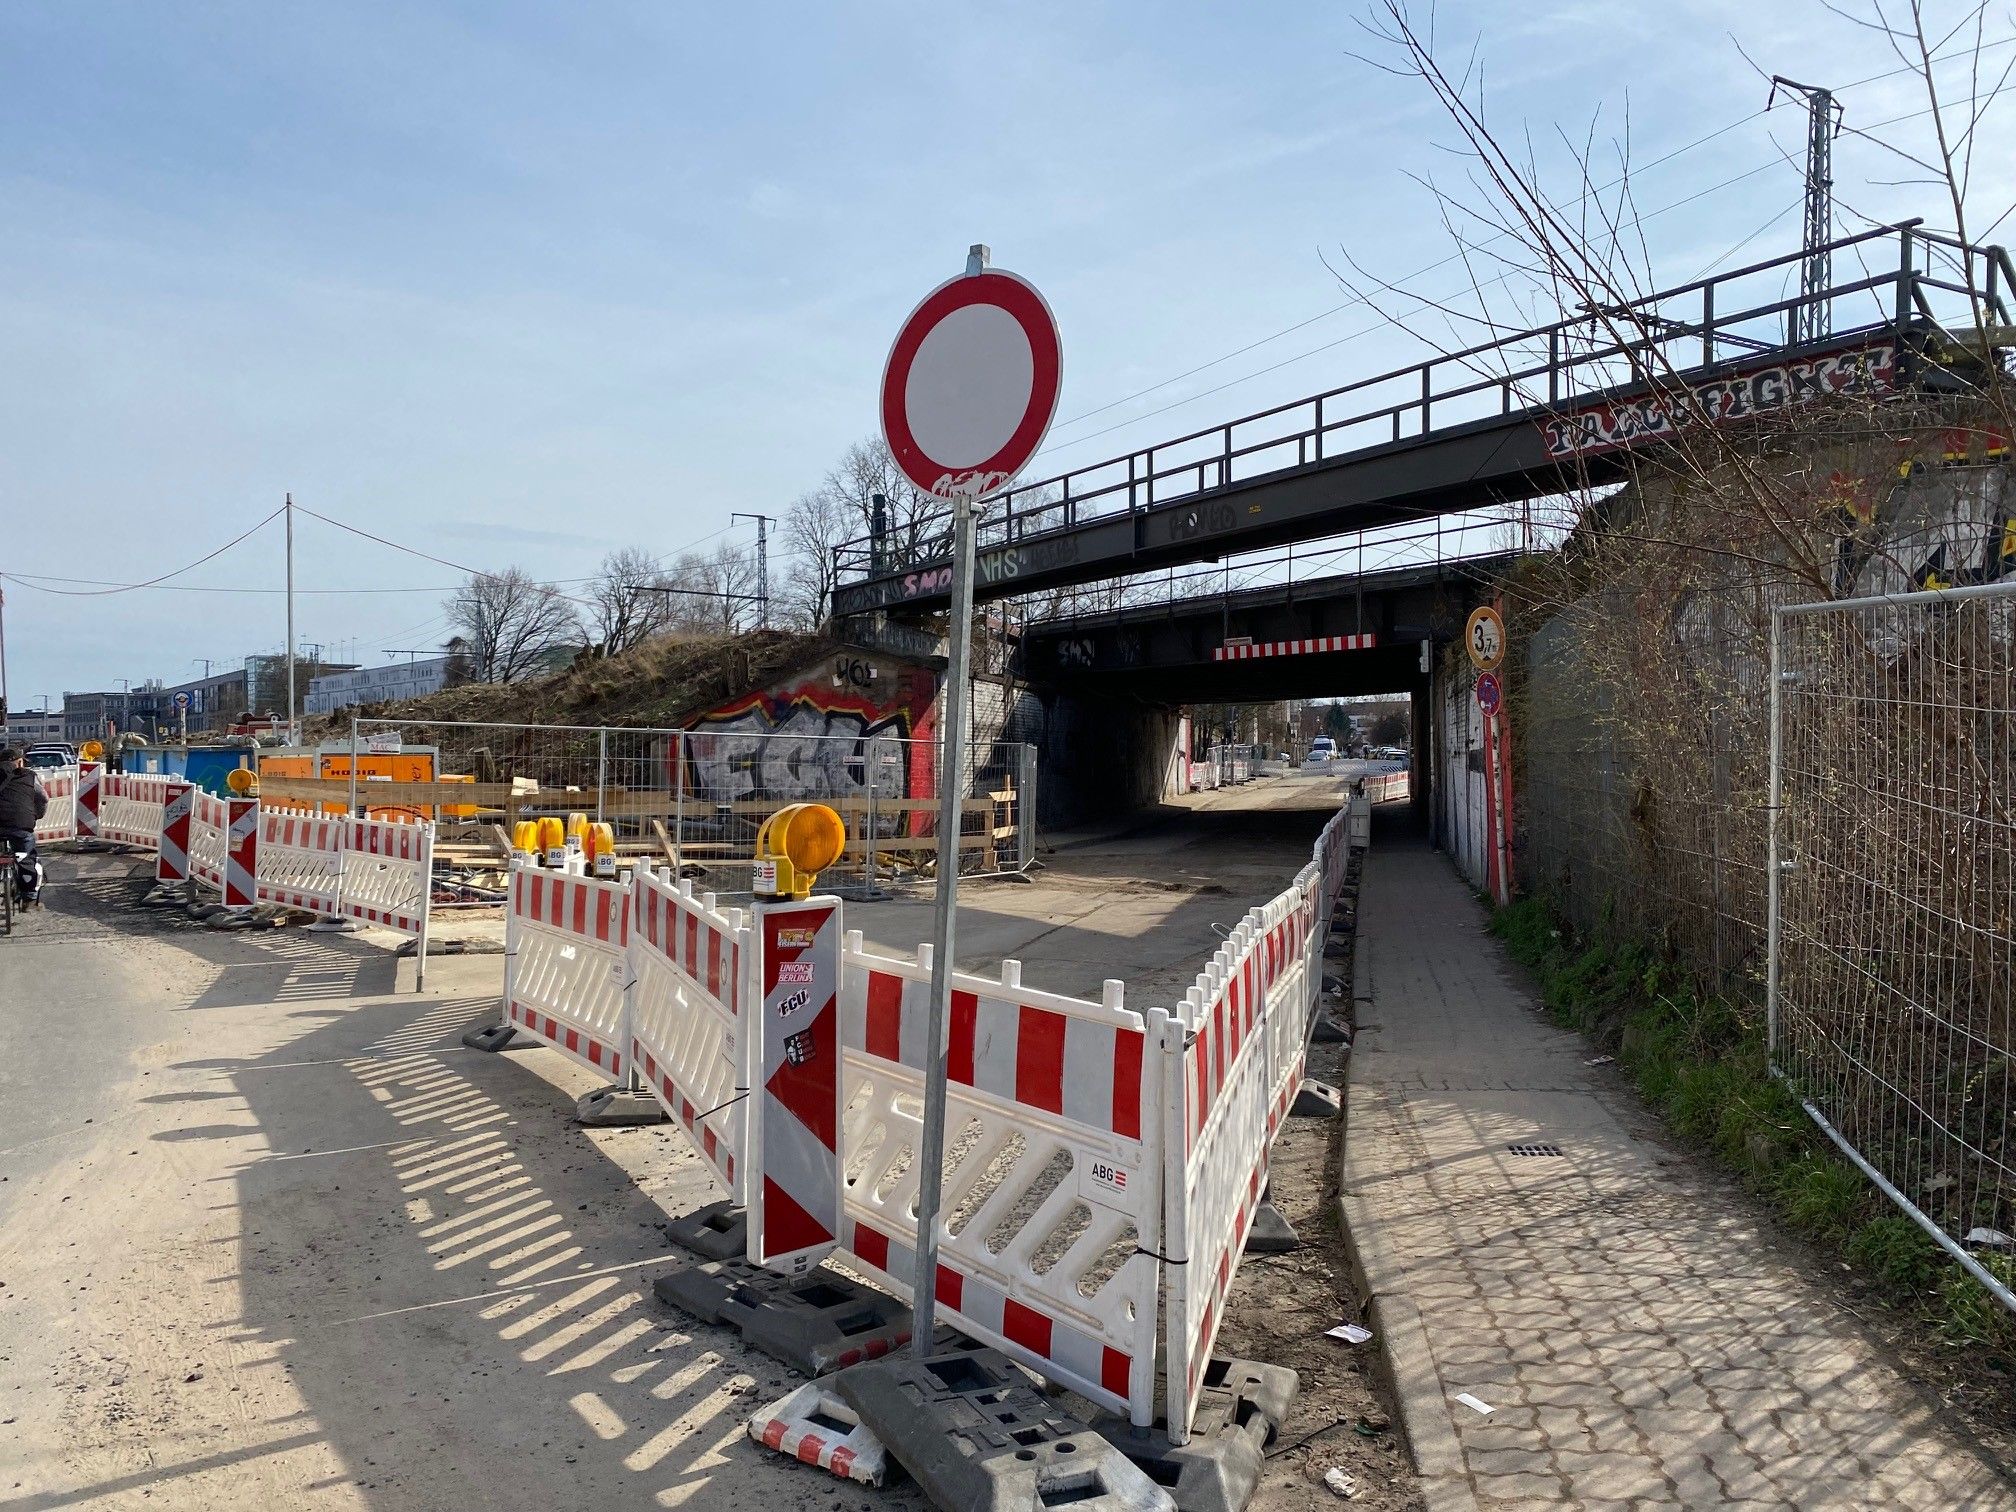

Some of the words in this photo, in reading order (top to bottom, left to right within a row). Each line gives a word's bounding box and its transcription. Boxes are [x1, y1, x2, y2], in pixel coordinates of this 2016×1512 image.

[780, 963, 806, 972] UNION
[779, 974, 806, 982] BERLIN
[780, 990, 807, 1016] FCU
[1092, 1162, 1114, 1182] ABG
